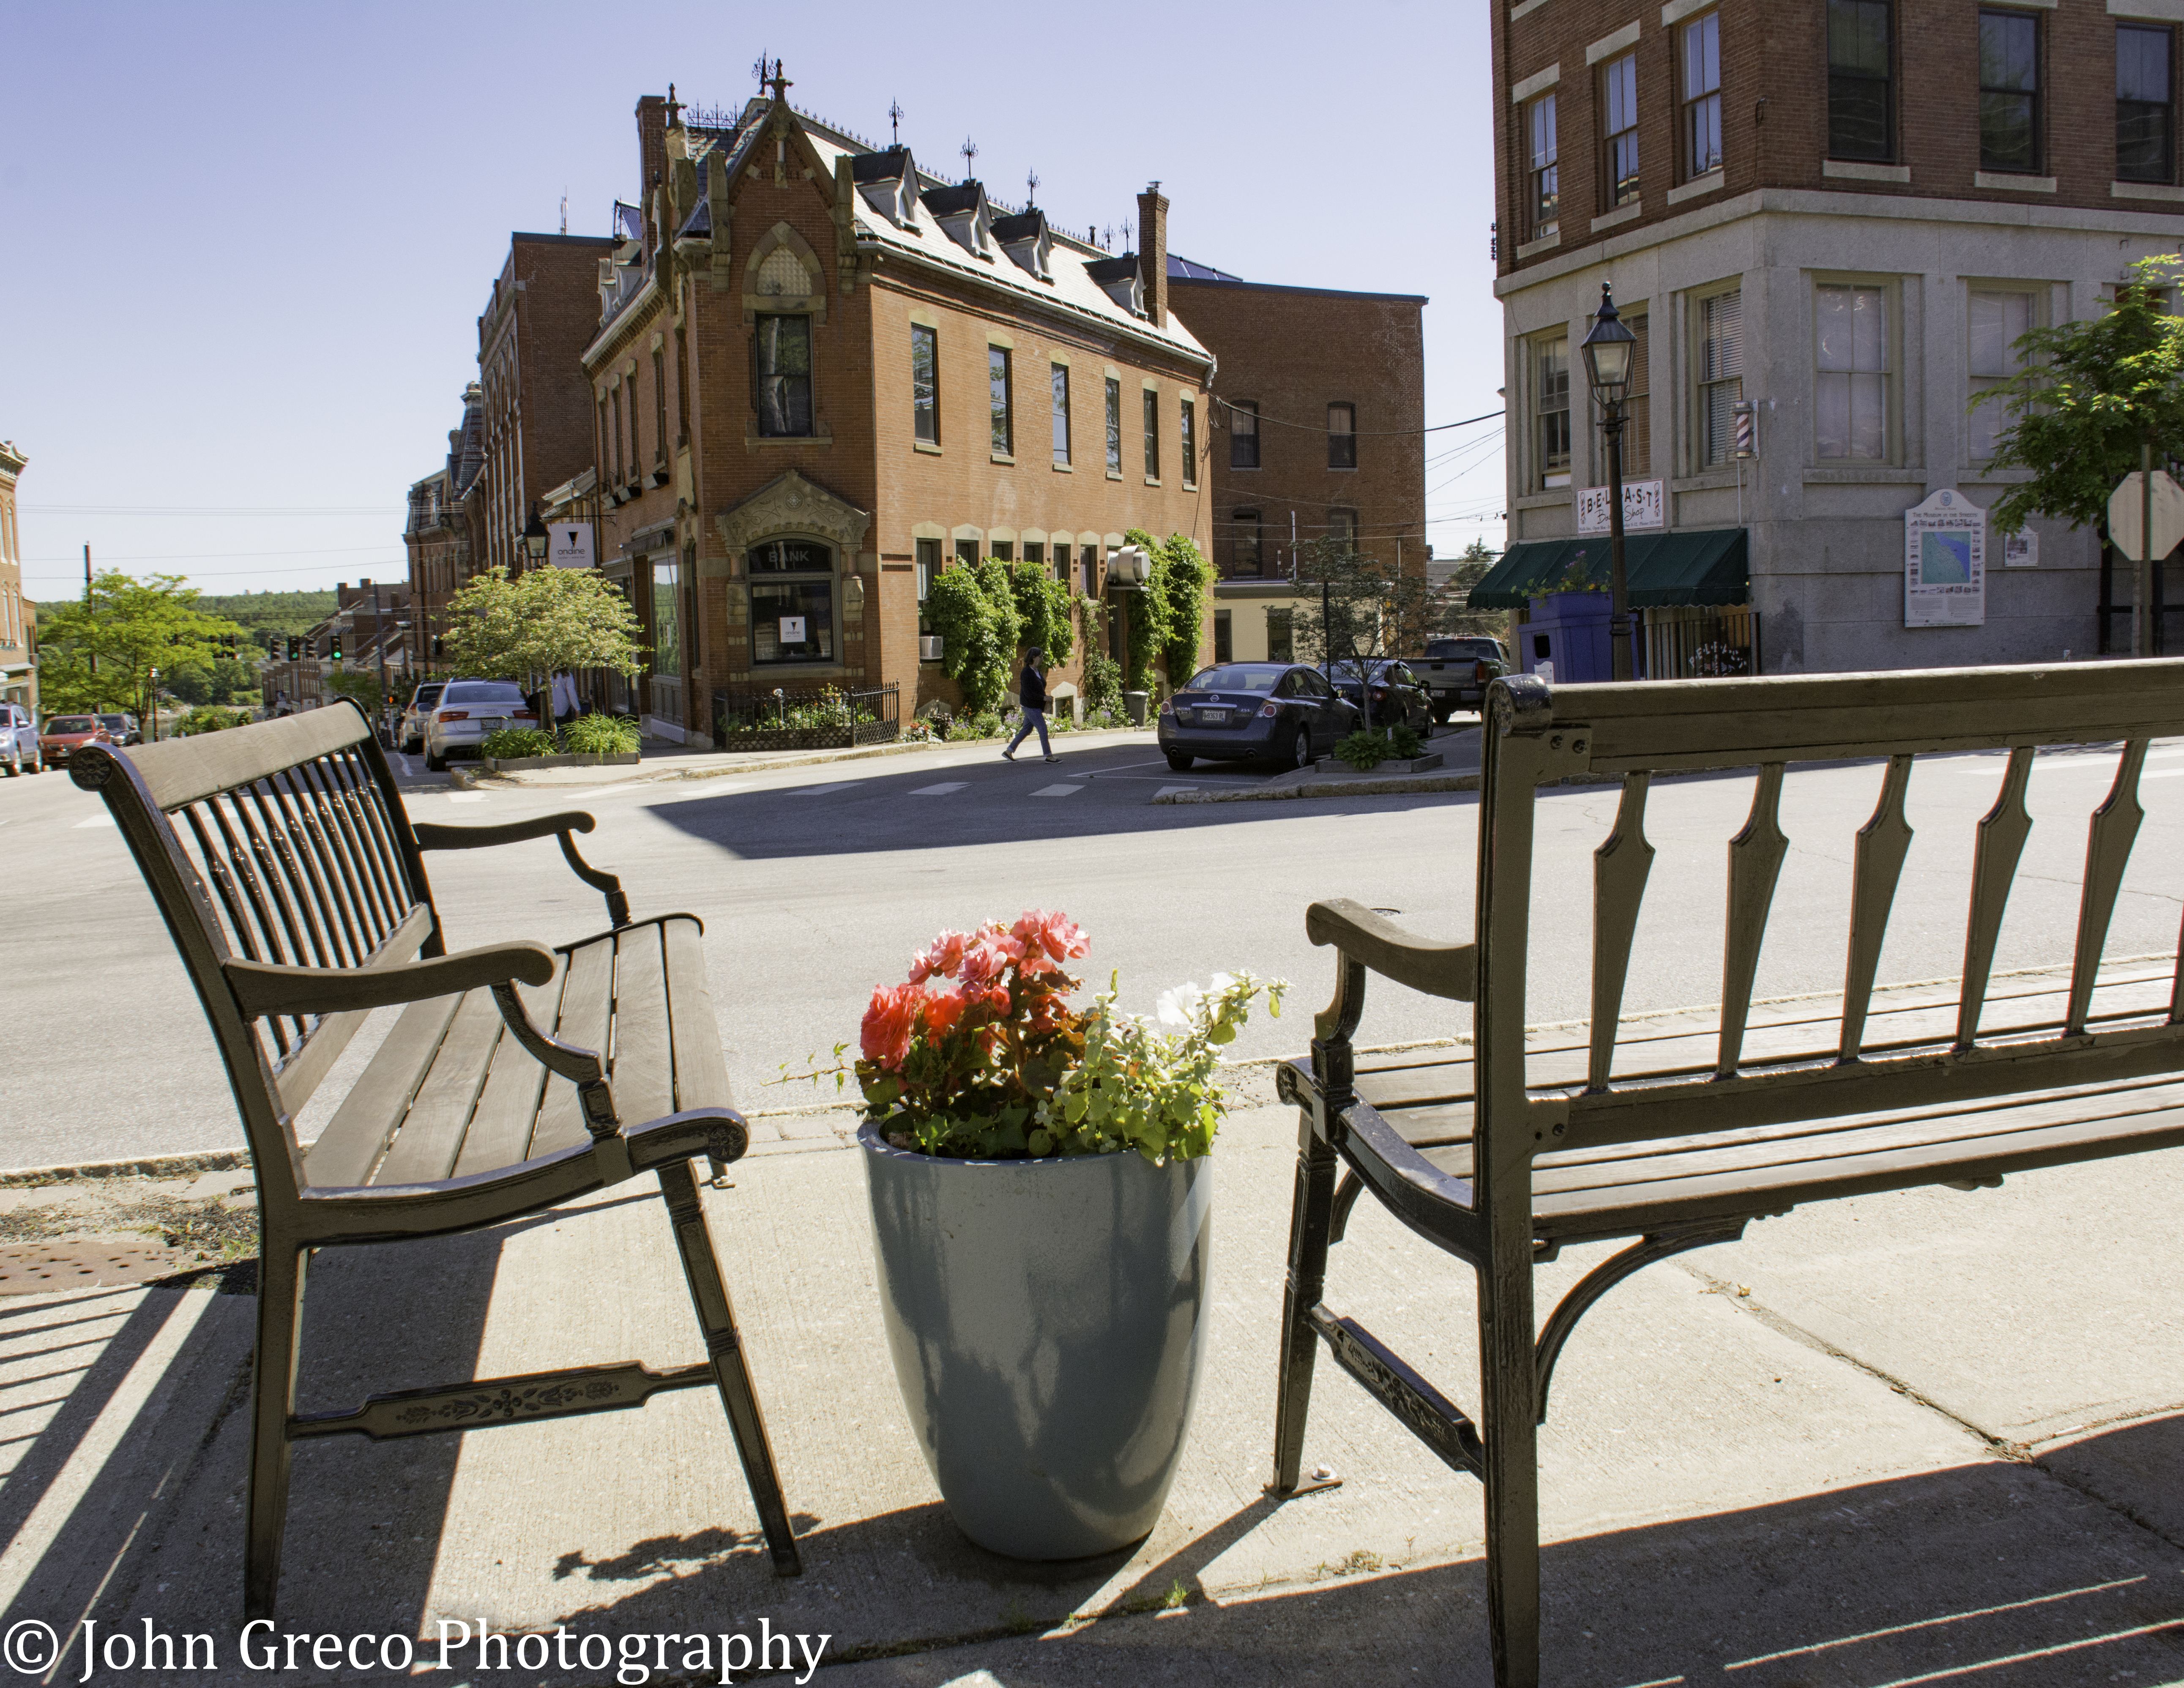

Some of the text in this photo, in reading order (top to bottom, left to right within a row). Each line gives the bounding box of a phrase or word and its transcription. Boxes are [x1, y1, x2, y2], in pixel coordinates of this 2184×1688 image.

[1587, 487, 1652, 514] BELAST
[1624, 505, 1644, 521] Shop
[768, 550, 809, 562] BANK
